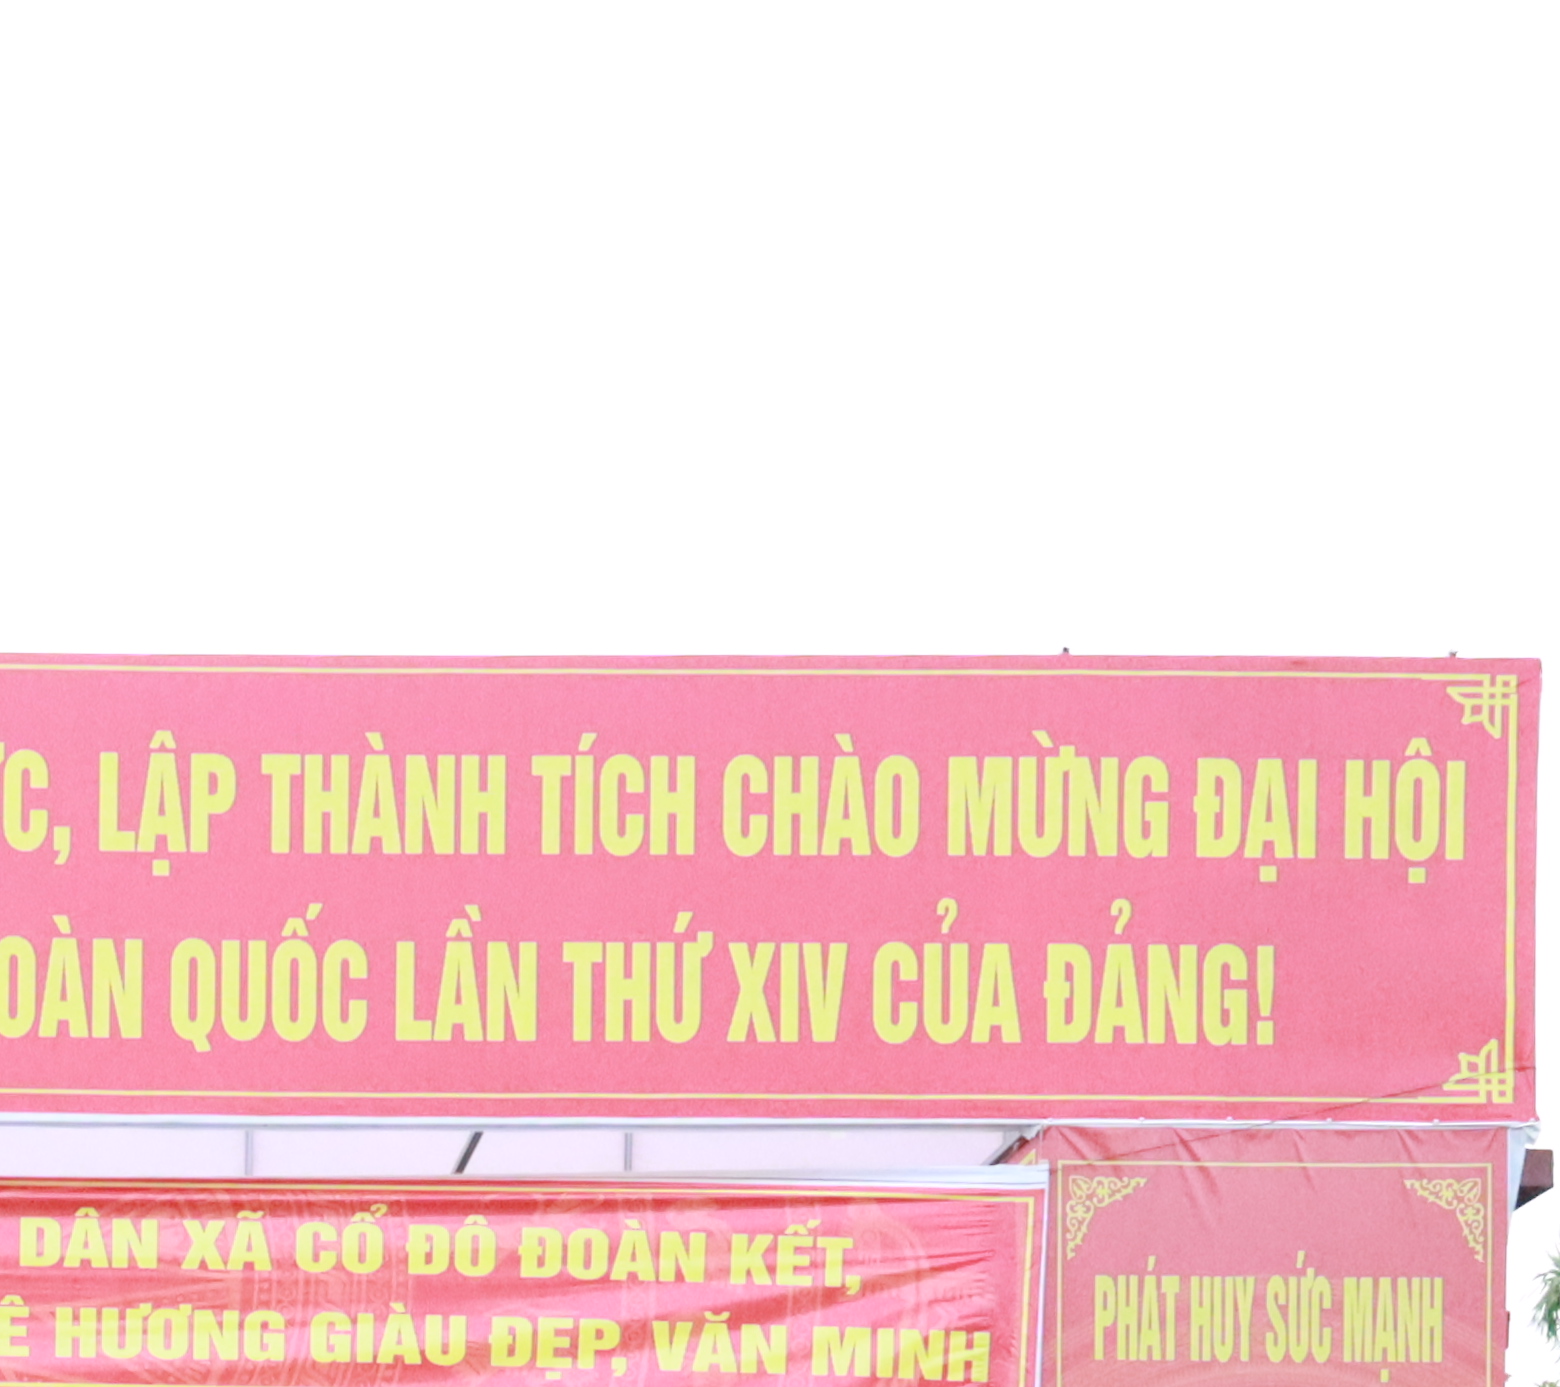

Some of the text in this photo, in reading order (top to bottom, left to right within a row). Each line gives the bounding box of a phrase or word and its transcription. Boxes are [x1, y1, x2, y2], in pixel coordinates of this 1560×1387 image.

[100, 732, 235, 874] LẬP
[263, 733, 505, 853] THÀNH
[533, 735, 695, 855] TÍCH
[724, 735, 919, 856] CHÀO
[949, 732, 1169, 857] MỪNG
[1195, 759, 1317, 881] ĐẠI
[1346, 739, 1464, 882] HỘI
[172, 904, 367, 1051] QUỐC
[397, 906, 537, 1040] LẦN
[564, 913, 713, 1042] THỨ
[729, 943, 847, 1041] XIV
[874, 899, 1020, 1043] CỦA
[1045, 900, 1273, 1044] ĐẢNG!
[20, 1208, 158, 1268] DÂN
[183, 1211, 272, 1270] XÃ
[297, 1205, 387, 1273] CỔ
[407, 1217, 496, 1275] ĐÔ
[519, 1221, 706, 1282] ĐOÀN
[731, 1221, 861, 1294] KẾT,
[56, 1304, 285, 1360] HƯƠNG
[312, 1303, 466, 1365] GIÀU
[491, 1318, 626, 1378] ĐẸP,
[653, 1313, 787, 1373] VĂN
[813, 1327, 990, 1381] MINH
[1094, 1250, 1443, 1381] PHÁT HUY SỨC MẠNH
